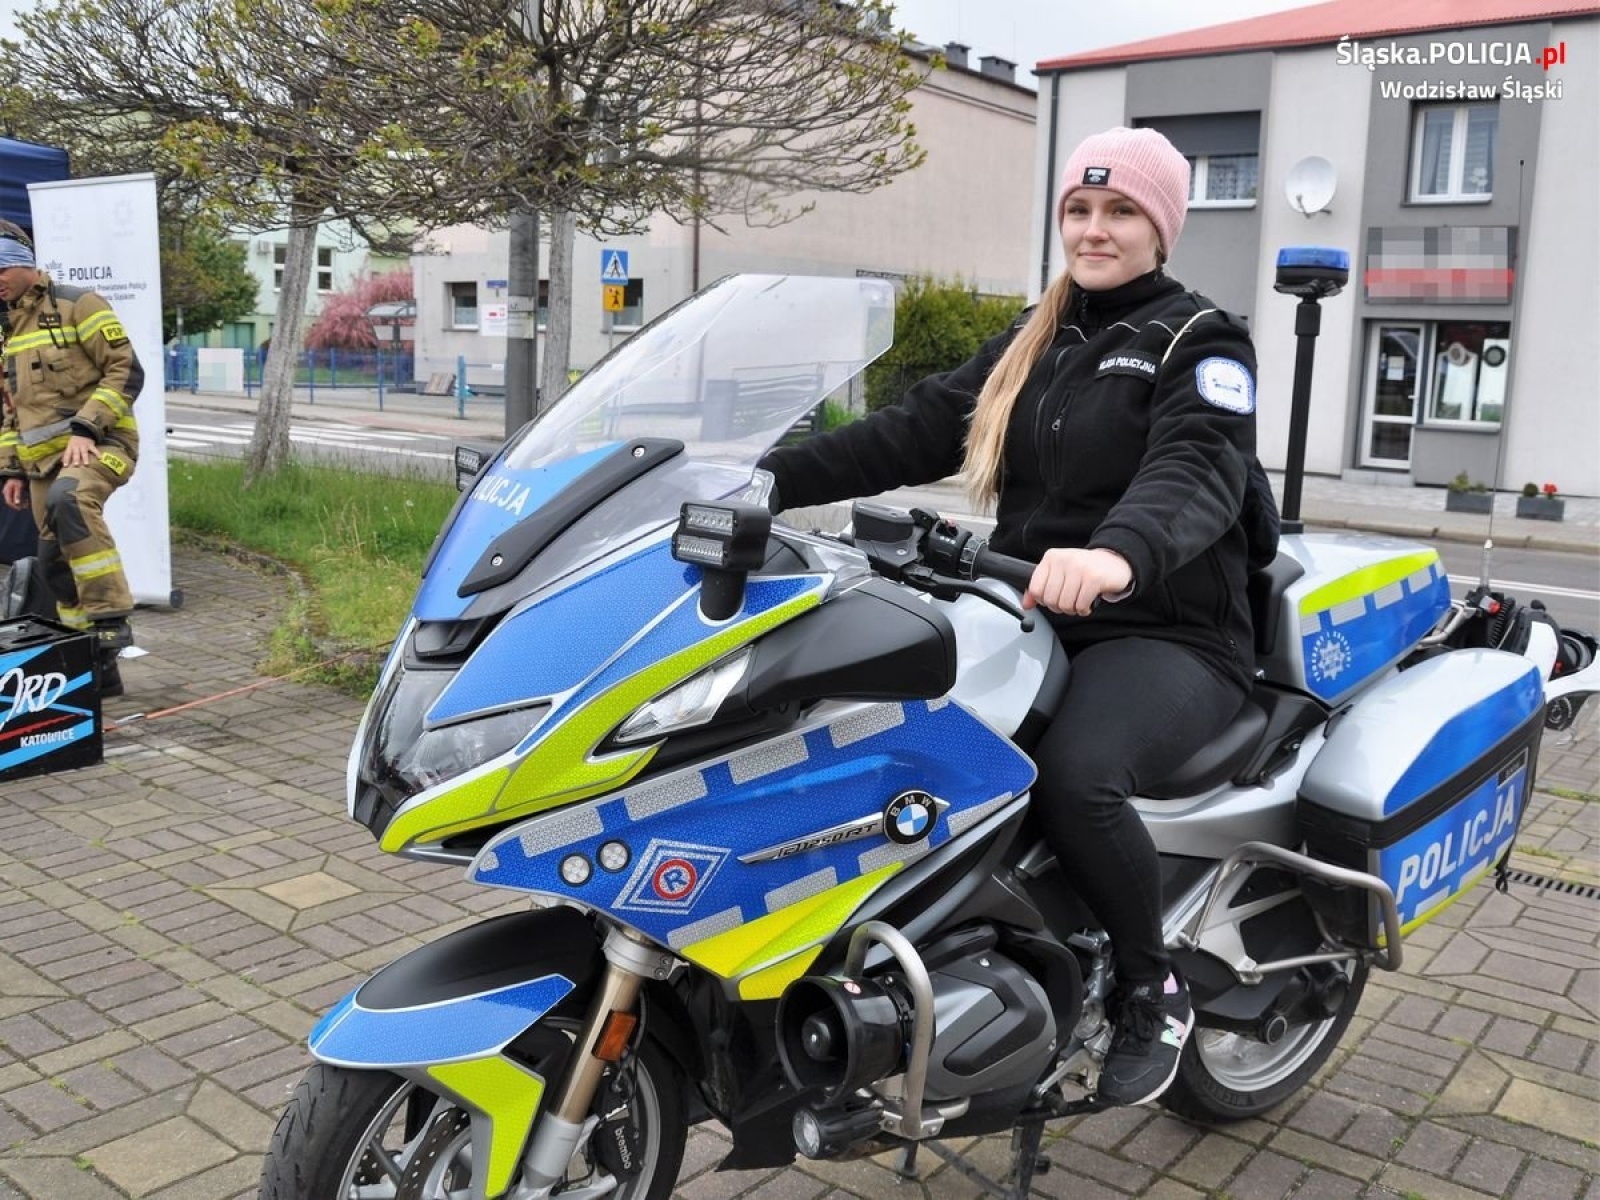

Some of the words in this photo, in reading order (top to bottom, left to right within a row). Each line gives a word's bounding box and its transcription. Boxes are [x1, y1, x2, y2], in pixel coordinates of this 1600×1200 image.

[68, 266, 113, 281] POLICJA
[468, 475, 532, 516] LICJA
[20, 727, 76, 748] KATOWICE
[890, 794, 932, 817] BMW
[1395, 783, 1516, 905] POLICJA
[663, 868, 688, 892] R
[614, 1124, 632, 1170] brembo
